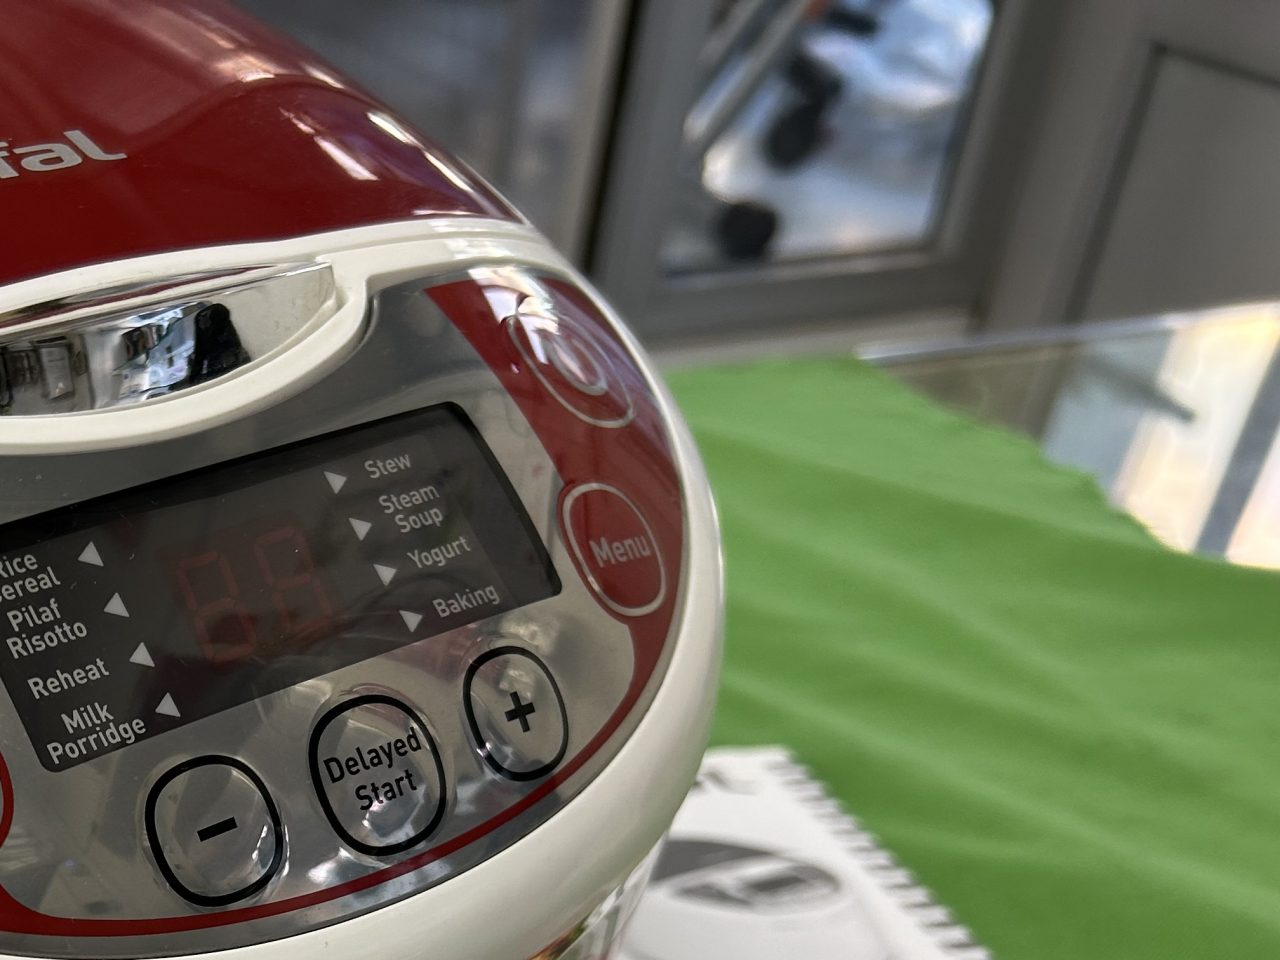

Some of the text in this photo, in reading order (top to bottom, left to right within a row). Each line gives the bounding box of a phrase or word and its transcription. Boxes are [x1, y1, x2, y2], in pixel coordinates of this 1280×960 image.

[364, 454, 412, 479] Stew
[378, 485, 440, 514] Steam
[394, 507, 443, 533] Soup
[407, 535, 471, 568] Yogurt
[589, 534, 651, 568] Menu
[6, 598, 62, 632] Pilaf
[432, 585, 500, 618] Baking
[6, 621, 88, 659] Risotto
[27, 657, 109, 699] Reheat
[61, 702, 115, 734] Milk
[47, 718, 146, 764] Porridge
[323, 727, 422, 784] Delayed
[355, 769, 418, 811] Start
